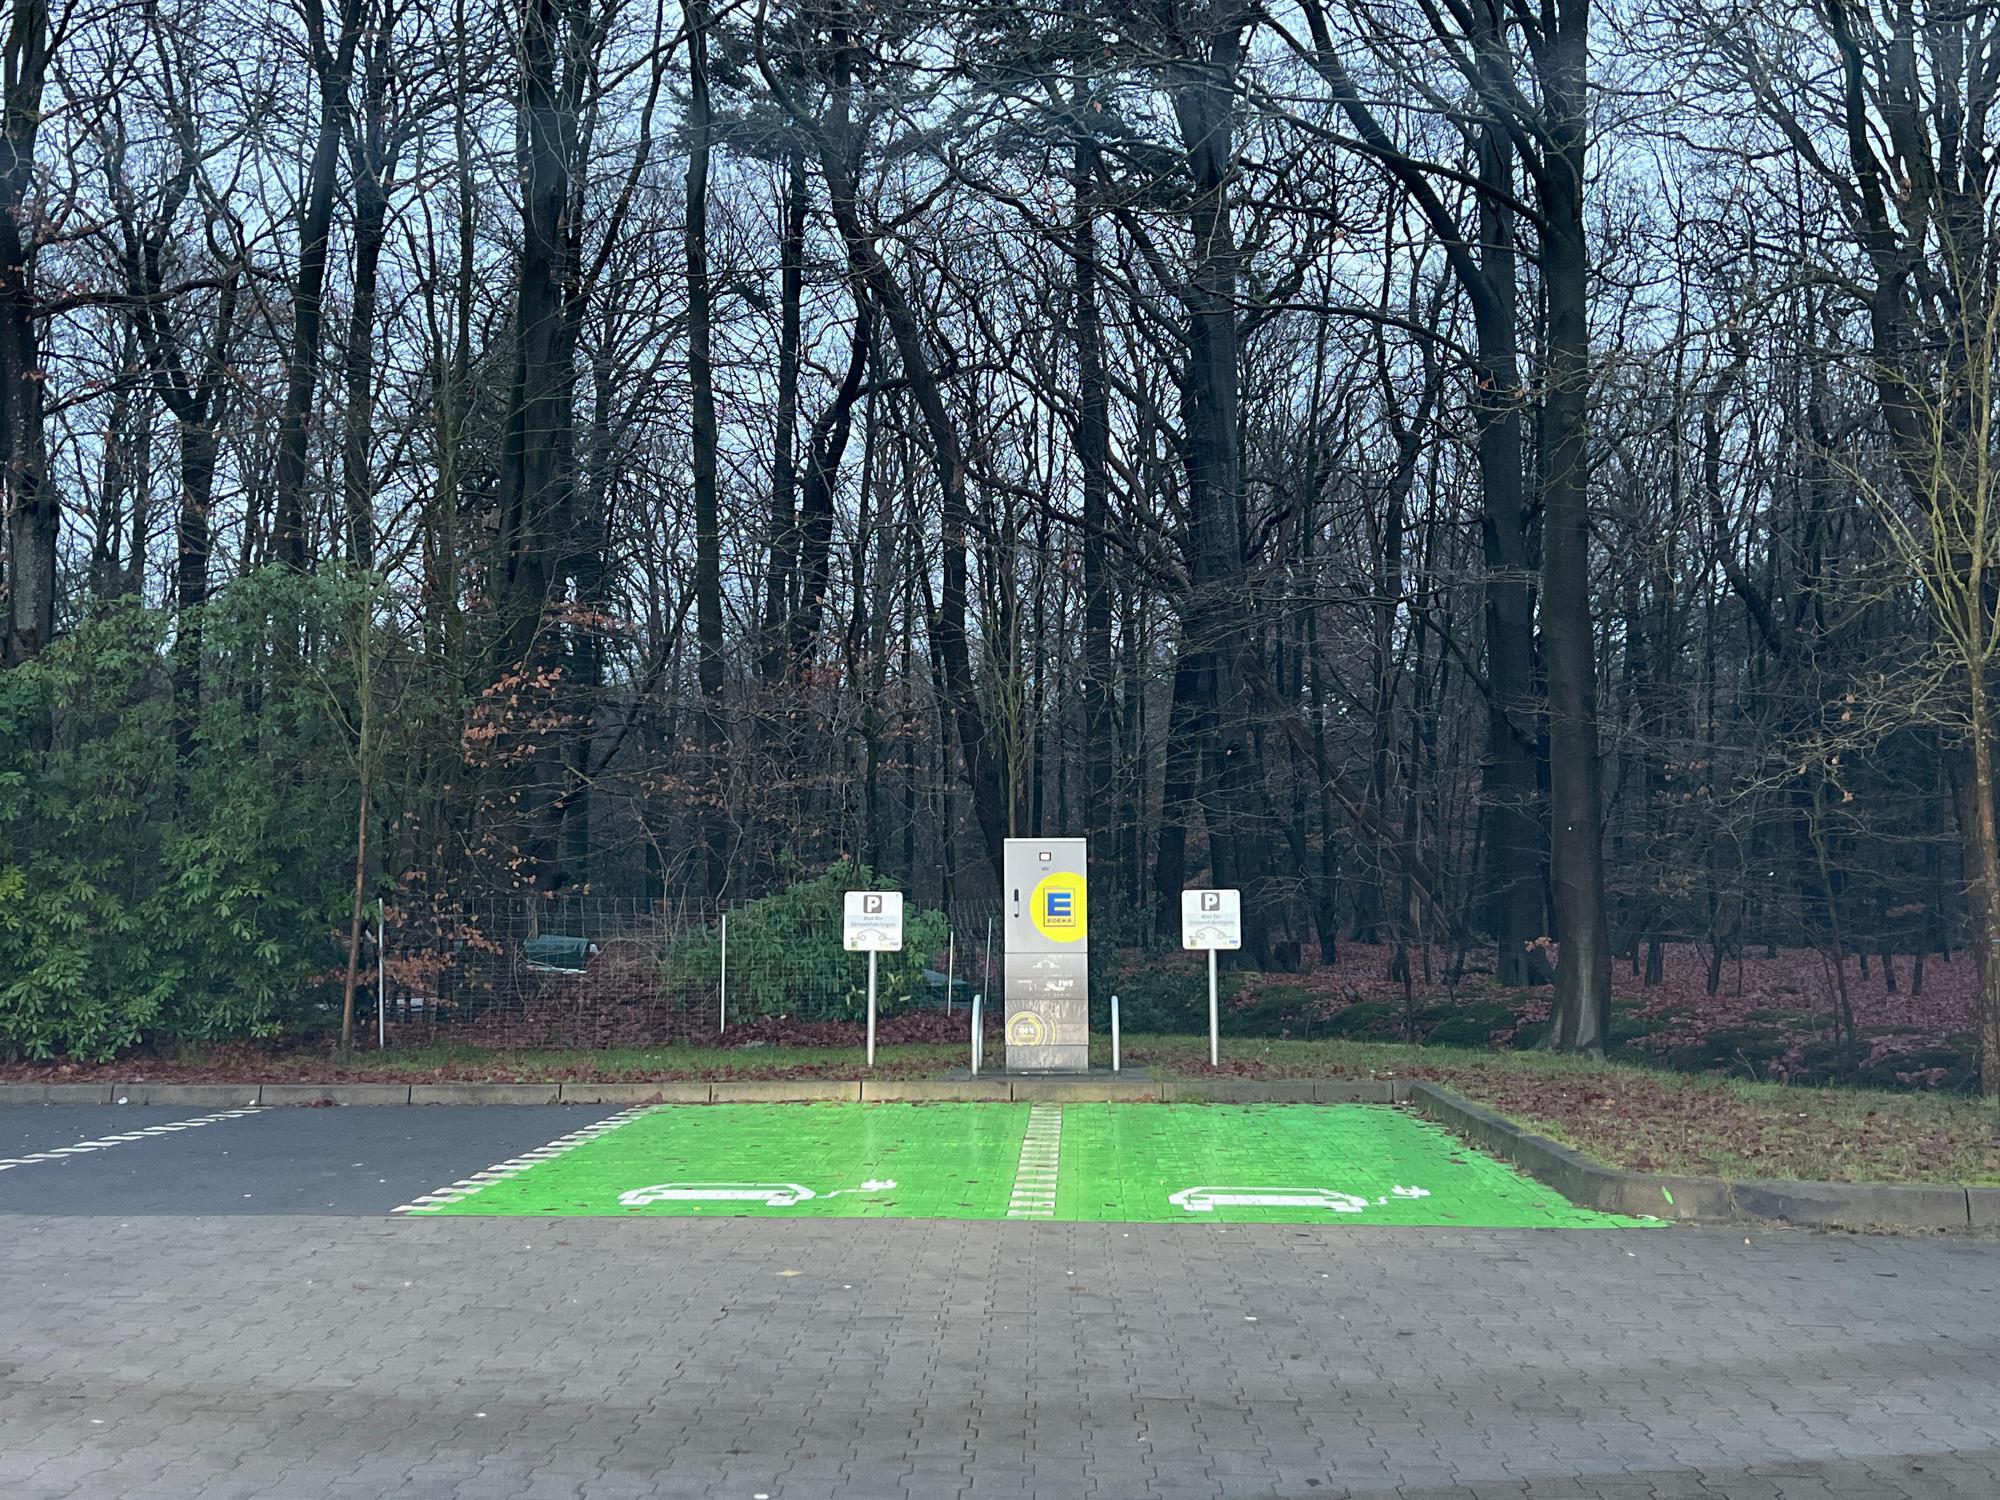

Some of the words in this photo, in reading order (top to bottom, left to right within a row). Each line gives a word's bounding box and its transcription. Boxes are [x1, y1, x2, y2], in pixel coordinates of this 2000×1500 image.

[867, 896, 880, 912] P
[1047, 892, 1072, 917] E
[1204, 893, 1217, 910] P
